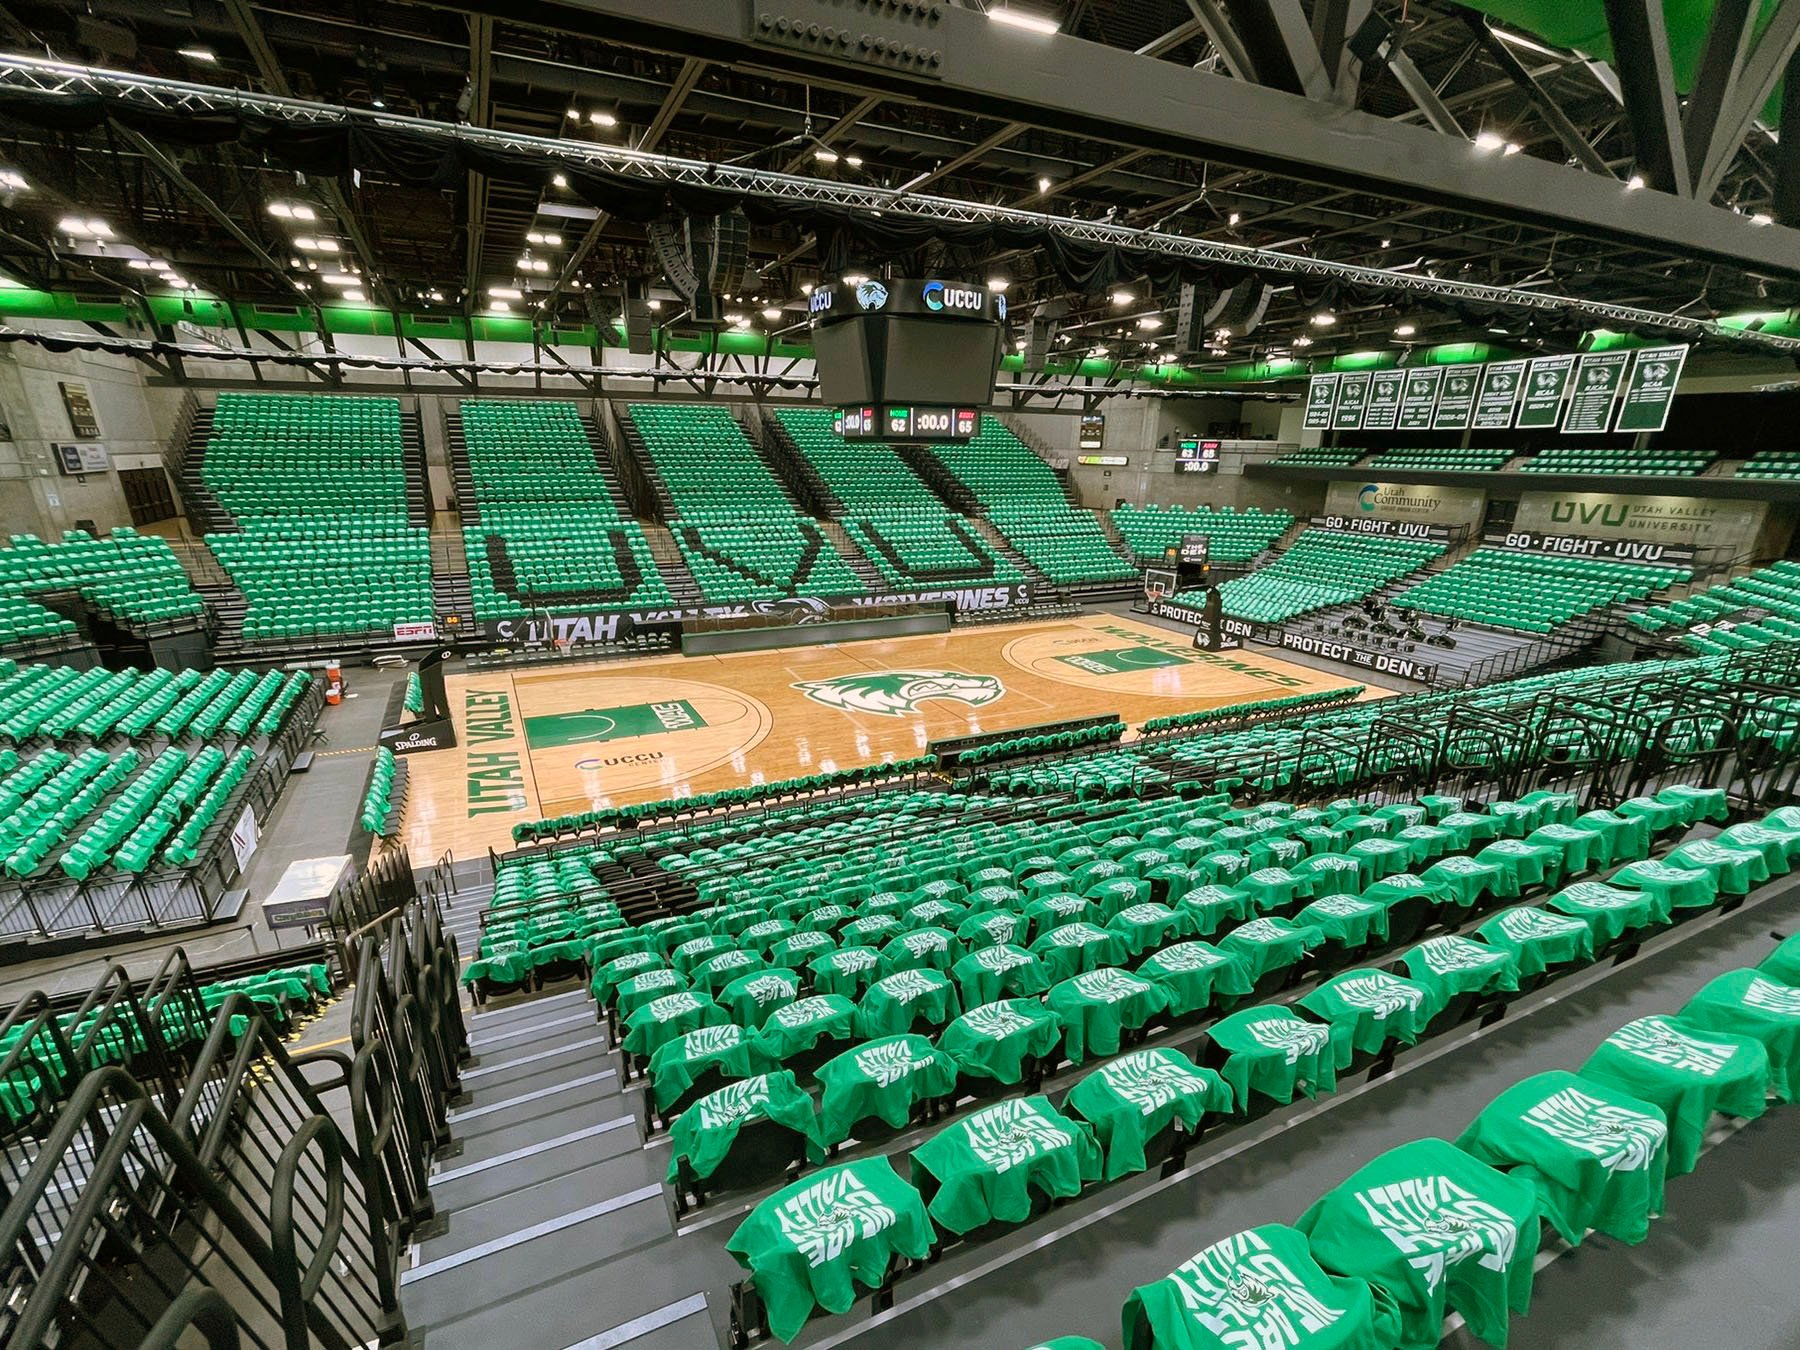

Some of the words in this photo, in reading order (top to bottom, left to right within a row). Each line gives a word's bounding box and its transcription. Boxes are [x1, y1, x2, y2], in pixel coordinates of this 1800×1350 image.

[943, 289, 982, 310] UCCU
[891, 420, 906, 432] 62
[917, 415, 948, 430] :00.0
[958, 421, 972, 434] 65
[1182, 448, 1194, 458] 62
[1202, 449, 1214, 458] 65
[1184, 461, 1208, 472] :00.0
[1374, 493, 1442, 512] Community
[1384, 487, 1405, 497] Utah
[1551, 501, 1630, 527] UVU
[1633, 504, 1663, 514] UTAH
[1669, 506, 1718, 518] VALLEY
[1326, 516, 1344, 529] GO
[1350, 518, 1391, 533] FIGHT
[1398, 523, 1430, 538] UVU
[1628, 519, 1712, 533] UNIVERSITY
[1504, 533, 1531, 549] GO
[1542, 536, 1602, 556] FIGHT
[1614, 542, 1664, 561] UVU
[396, 625, 432, 636] ESPN
[526, 614, 620, 642] UTAH
[1160, 604, 1204, 625] PROTEC
[1225, 620, 1252, 637] DEN
[1283, 633, 1353, 662] PROTECT
[1354, 652, 1374, 664] THE
[1376, 655, 1414, 677] DEN
[466, 689, 515, 747] VALLEY
[395, 736, 437, 750] SPALDING
[604, 752, 664, 766] UCCU
[468, 752, 528, 818] UTAH
[962, 1098, 1038, 1148] VALLEY
[774, 1168, 866, 1233] VALLEY
[1354, 1176, 1478, 1231] VALLEY
[797, 1218, 854, 1269] ARE
[1167, 1230, 1272, 1310] VALLEY
